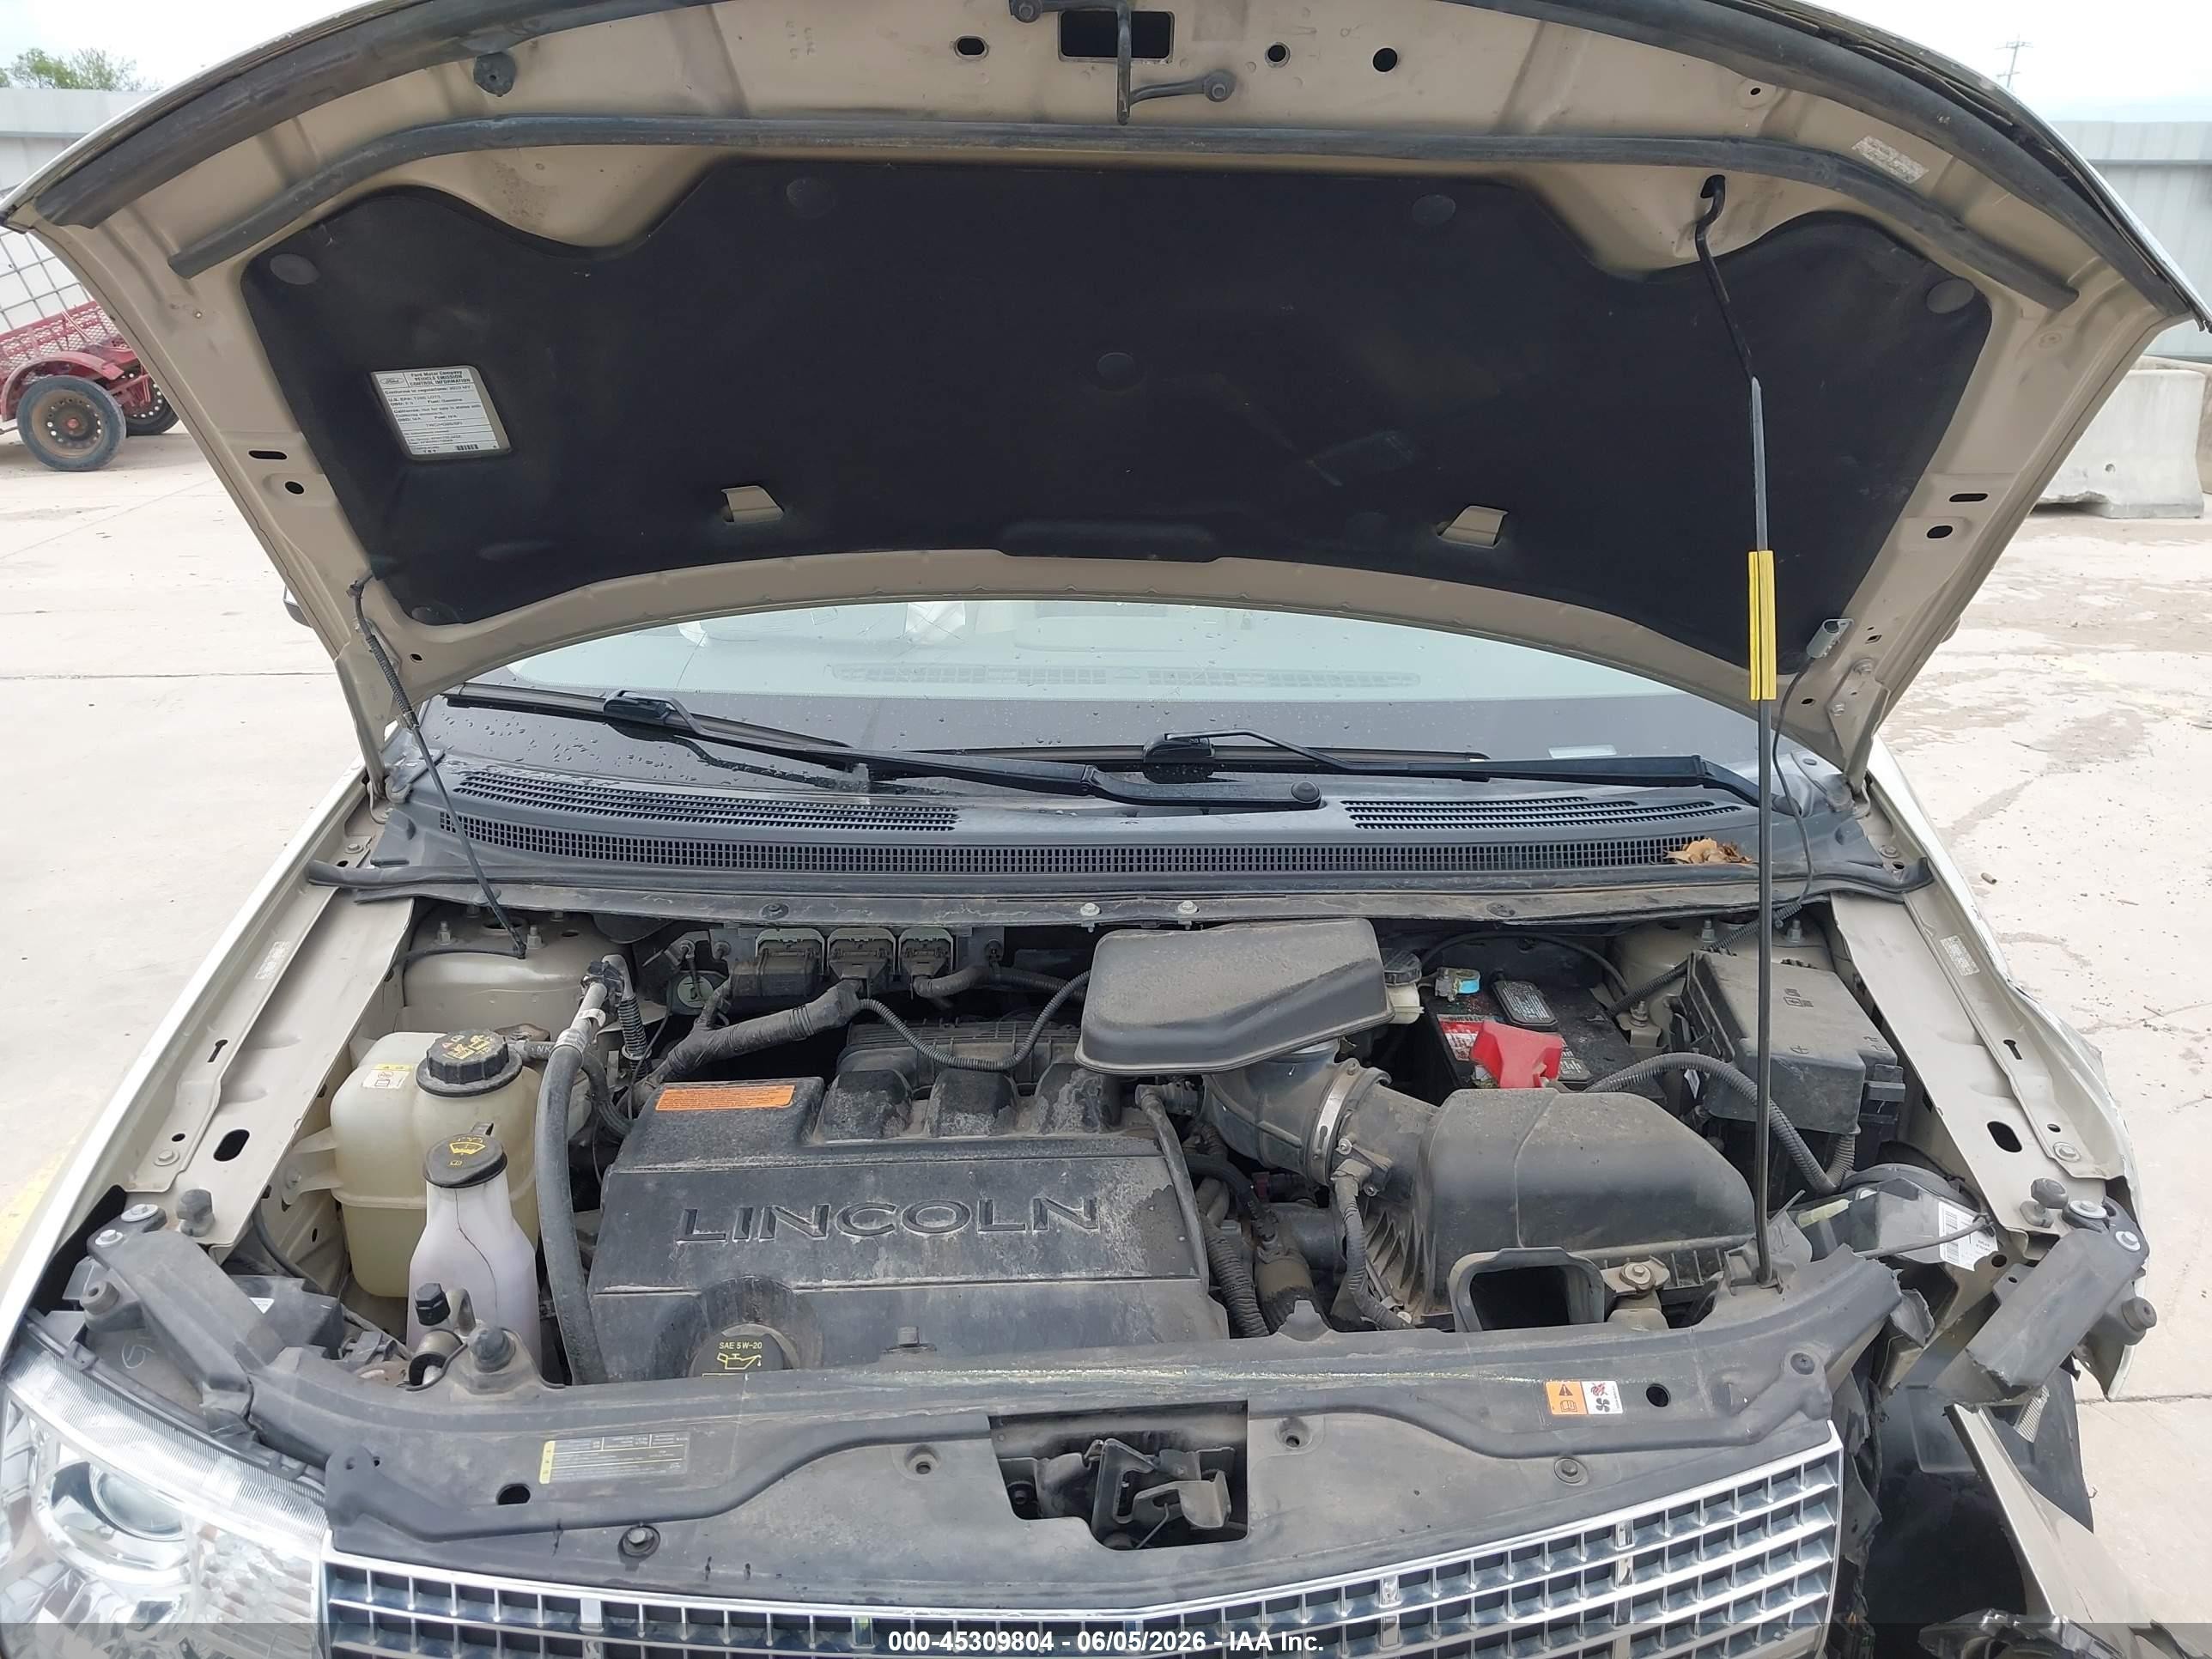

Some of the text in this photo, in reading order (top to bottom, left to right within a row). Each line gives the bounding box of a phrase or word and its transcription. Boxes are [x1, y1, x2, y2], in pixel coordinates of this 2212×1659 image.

[676, 1197, 1099, 1243] LINCOLN
[719, 1341, 763, 1350] SAE 5W-20
